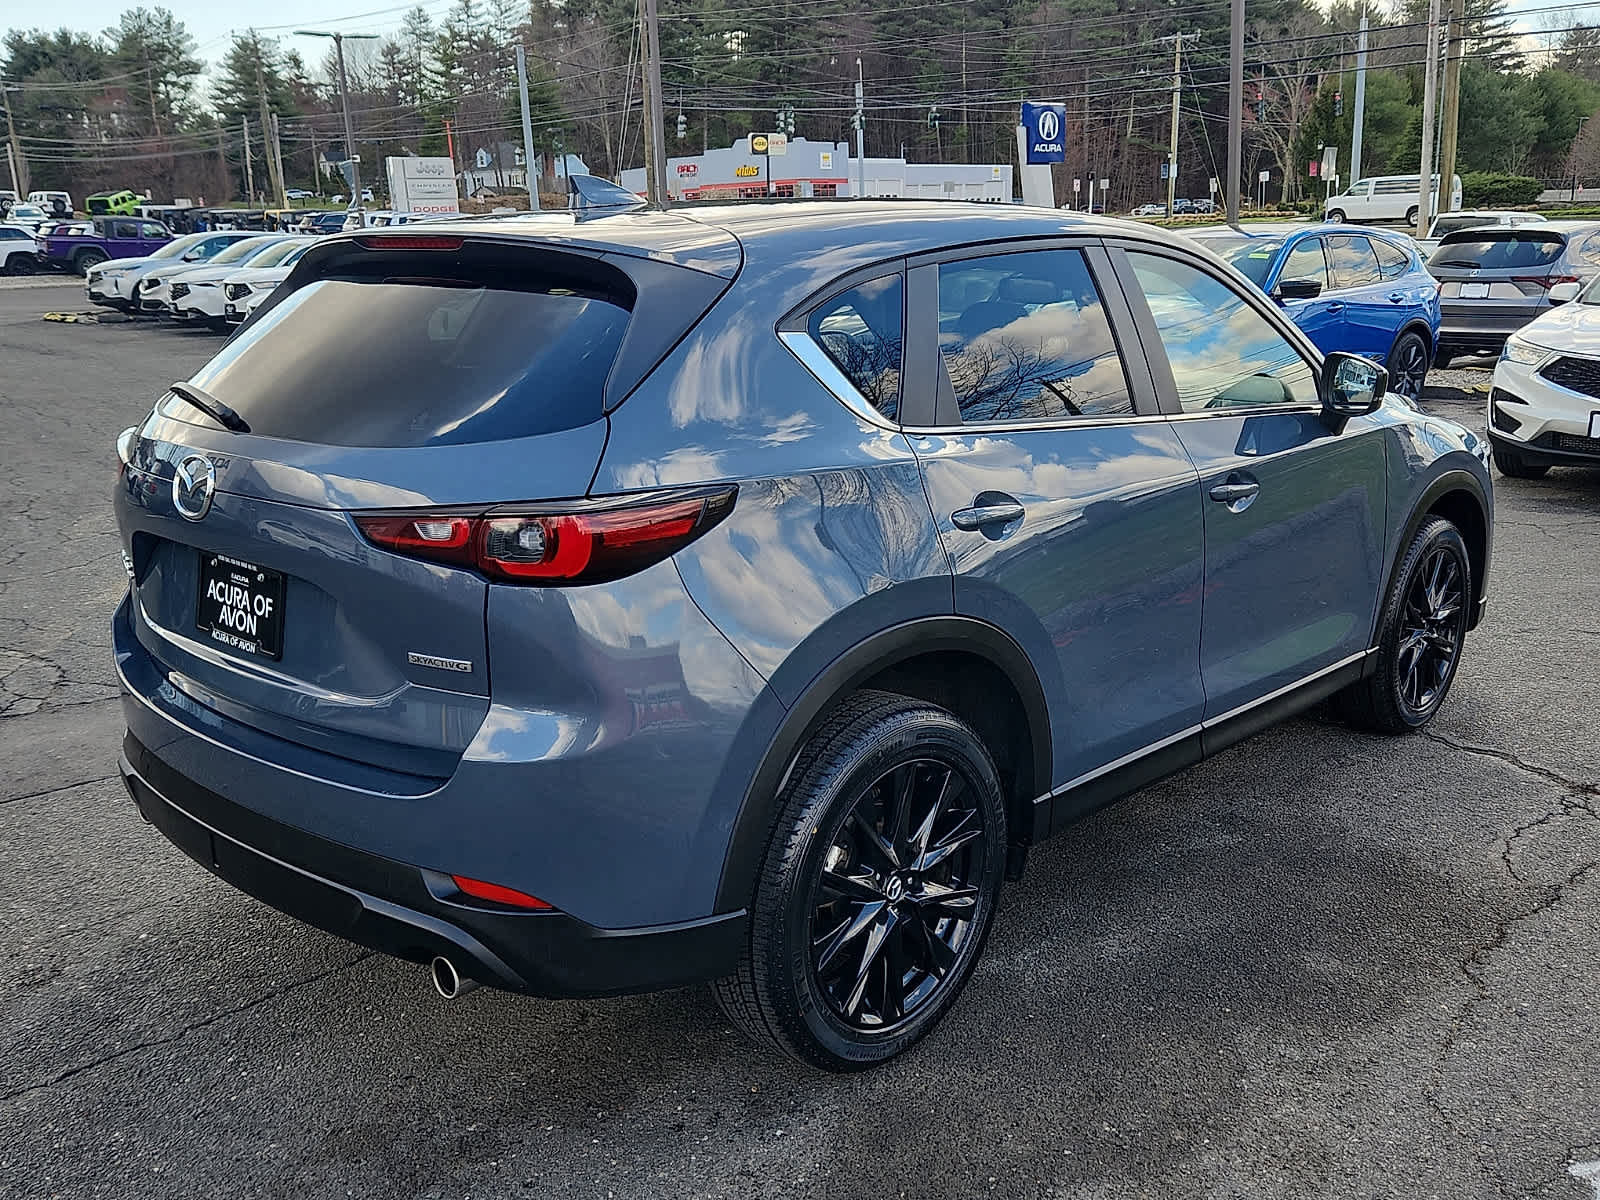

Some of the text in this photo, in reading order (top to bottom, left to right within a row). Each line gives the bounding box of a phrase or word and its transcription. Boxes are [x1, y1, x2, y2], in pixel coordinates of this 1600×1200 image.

[1034, 144, 1062, 152] ACURA
[416, 161, 444, 175] Jeep
[207, 578, 274, 618] ACURA OF
[218, 604, 257, 636] AVON
[211, 630, 256, 654] ACURA OF AVON
